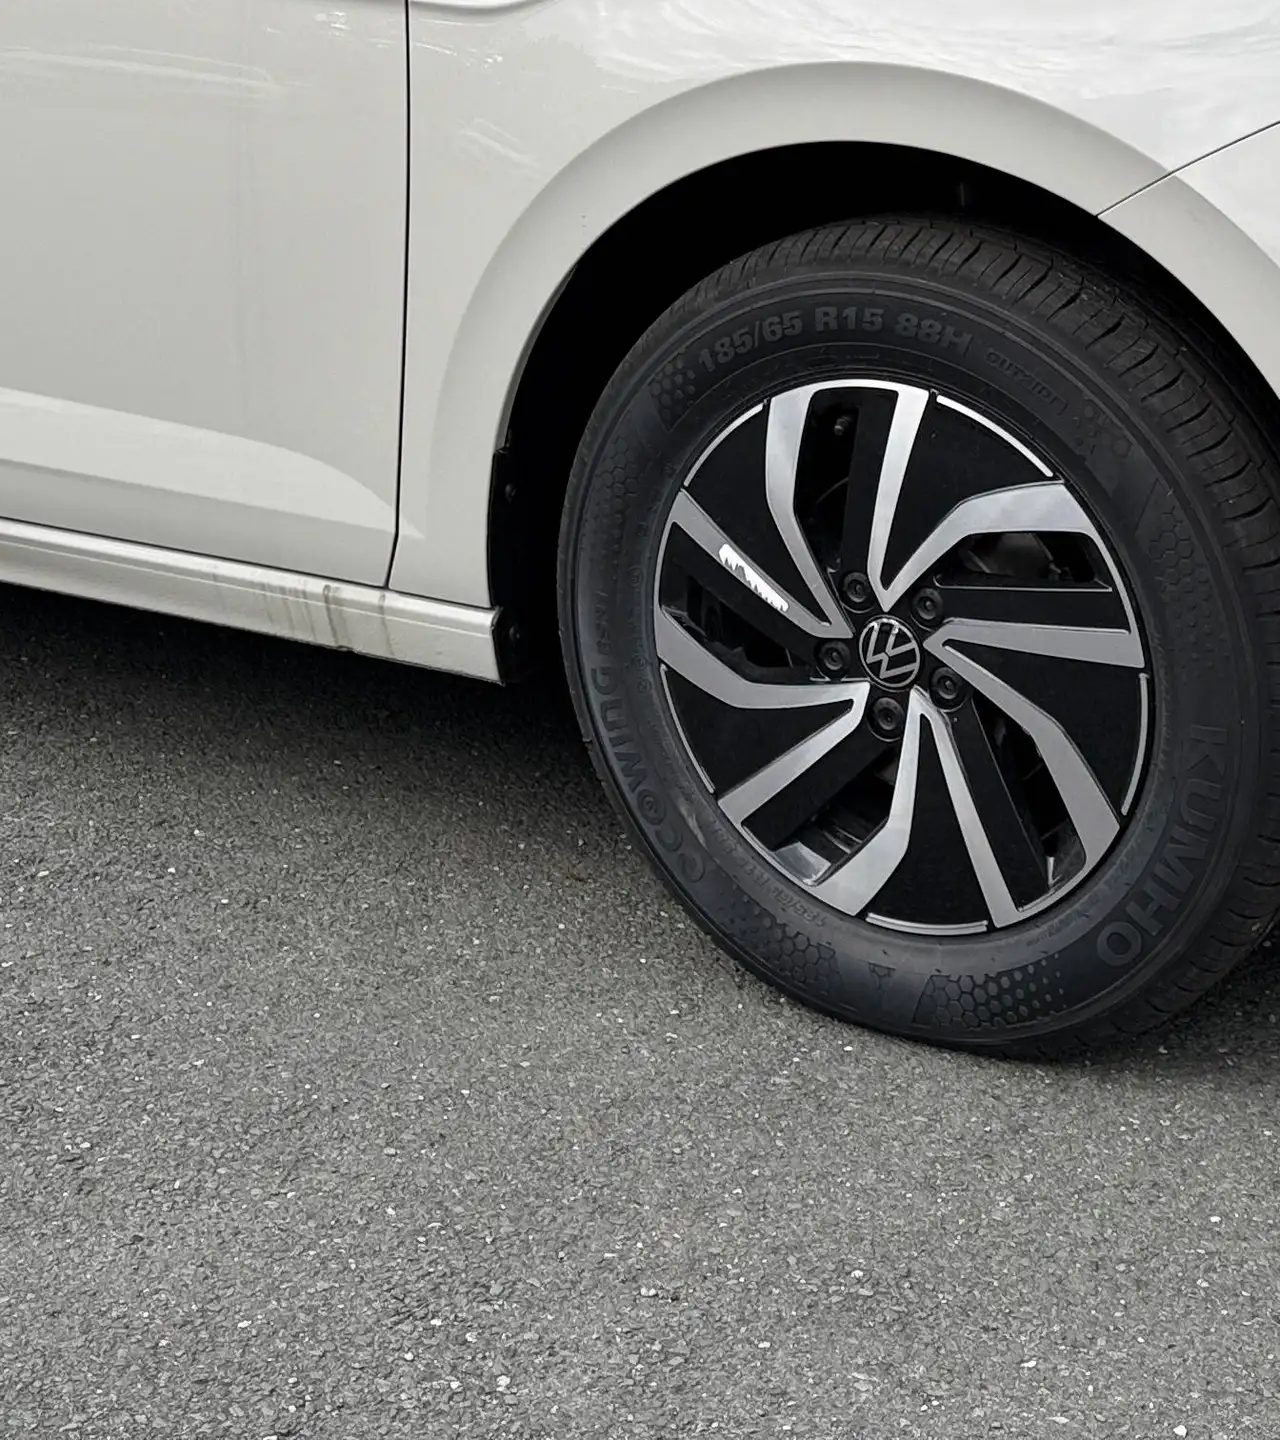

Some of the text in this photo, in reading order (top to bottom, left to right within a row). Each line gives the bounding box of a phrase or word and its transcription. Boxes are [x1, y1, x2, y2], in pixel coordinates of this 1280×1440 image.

[697, 306, 974, 372] 185/65 R15 88H
[1096, 723, 1228, 967] KUMHO
